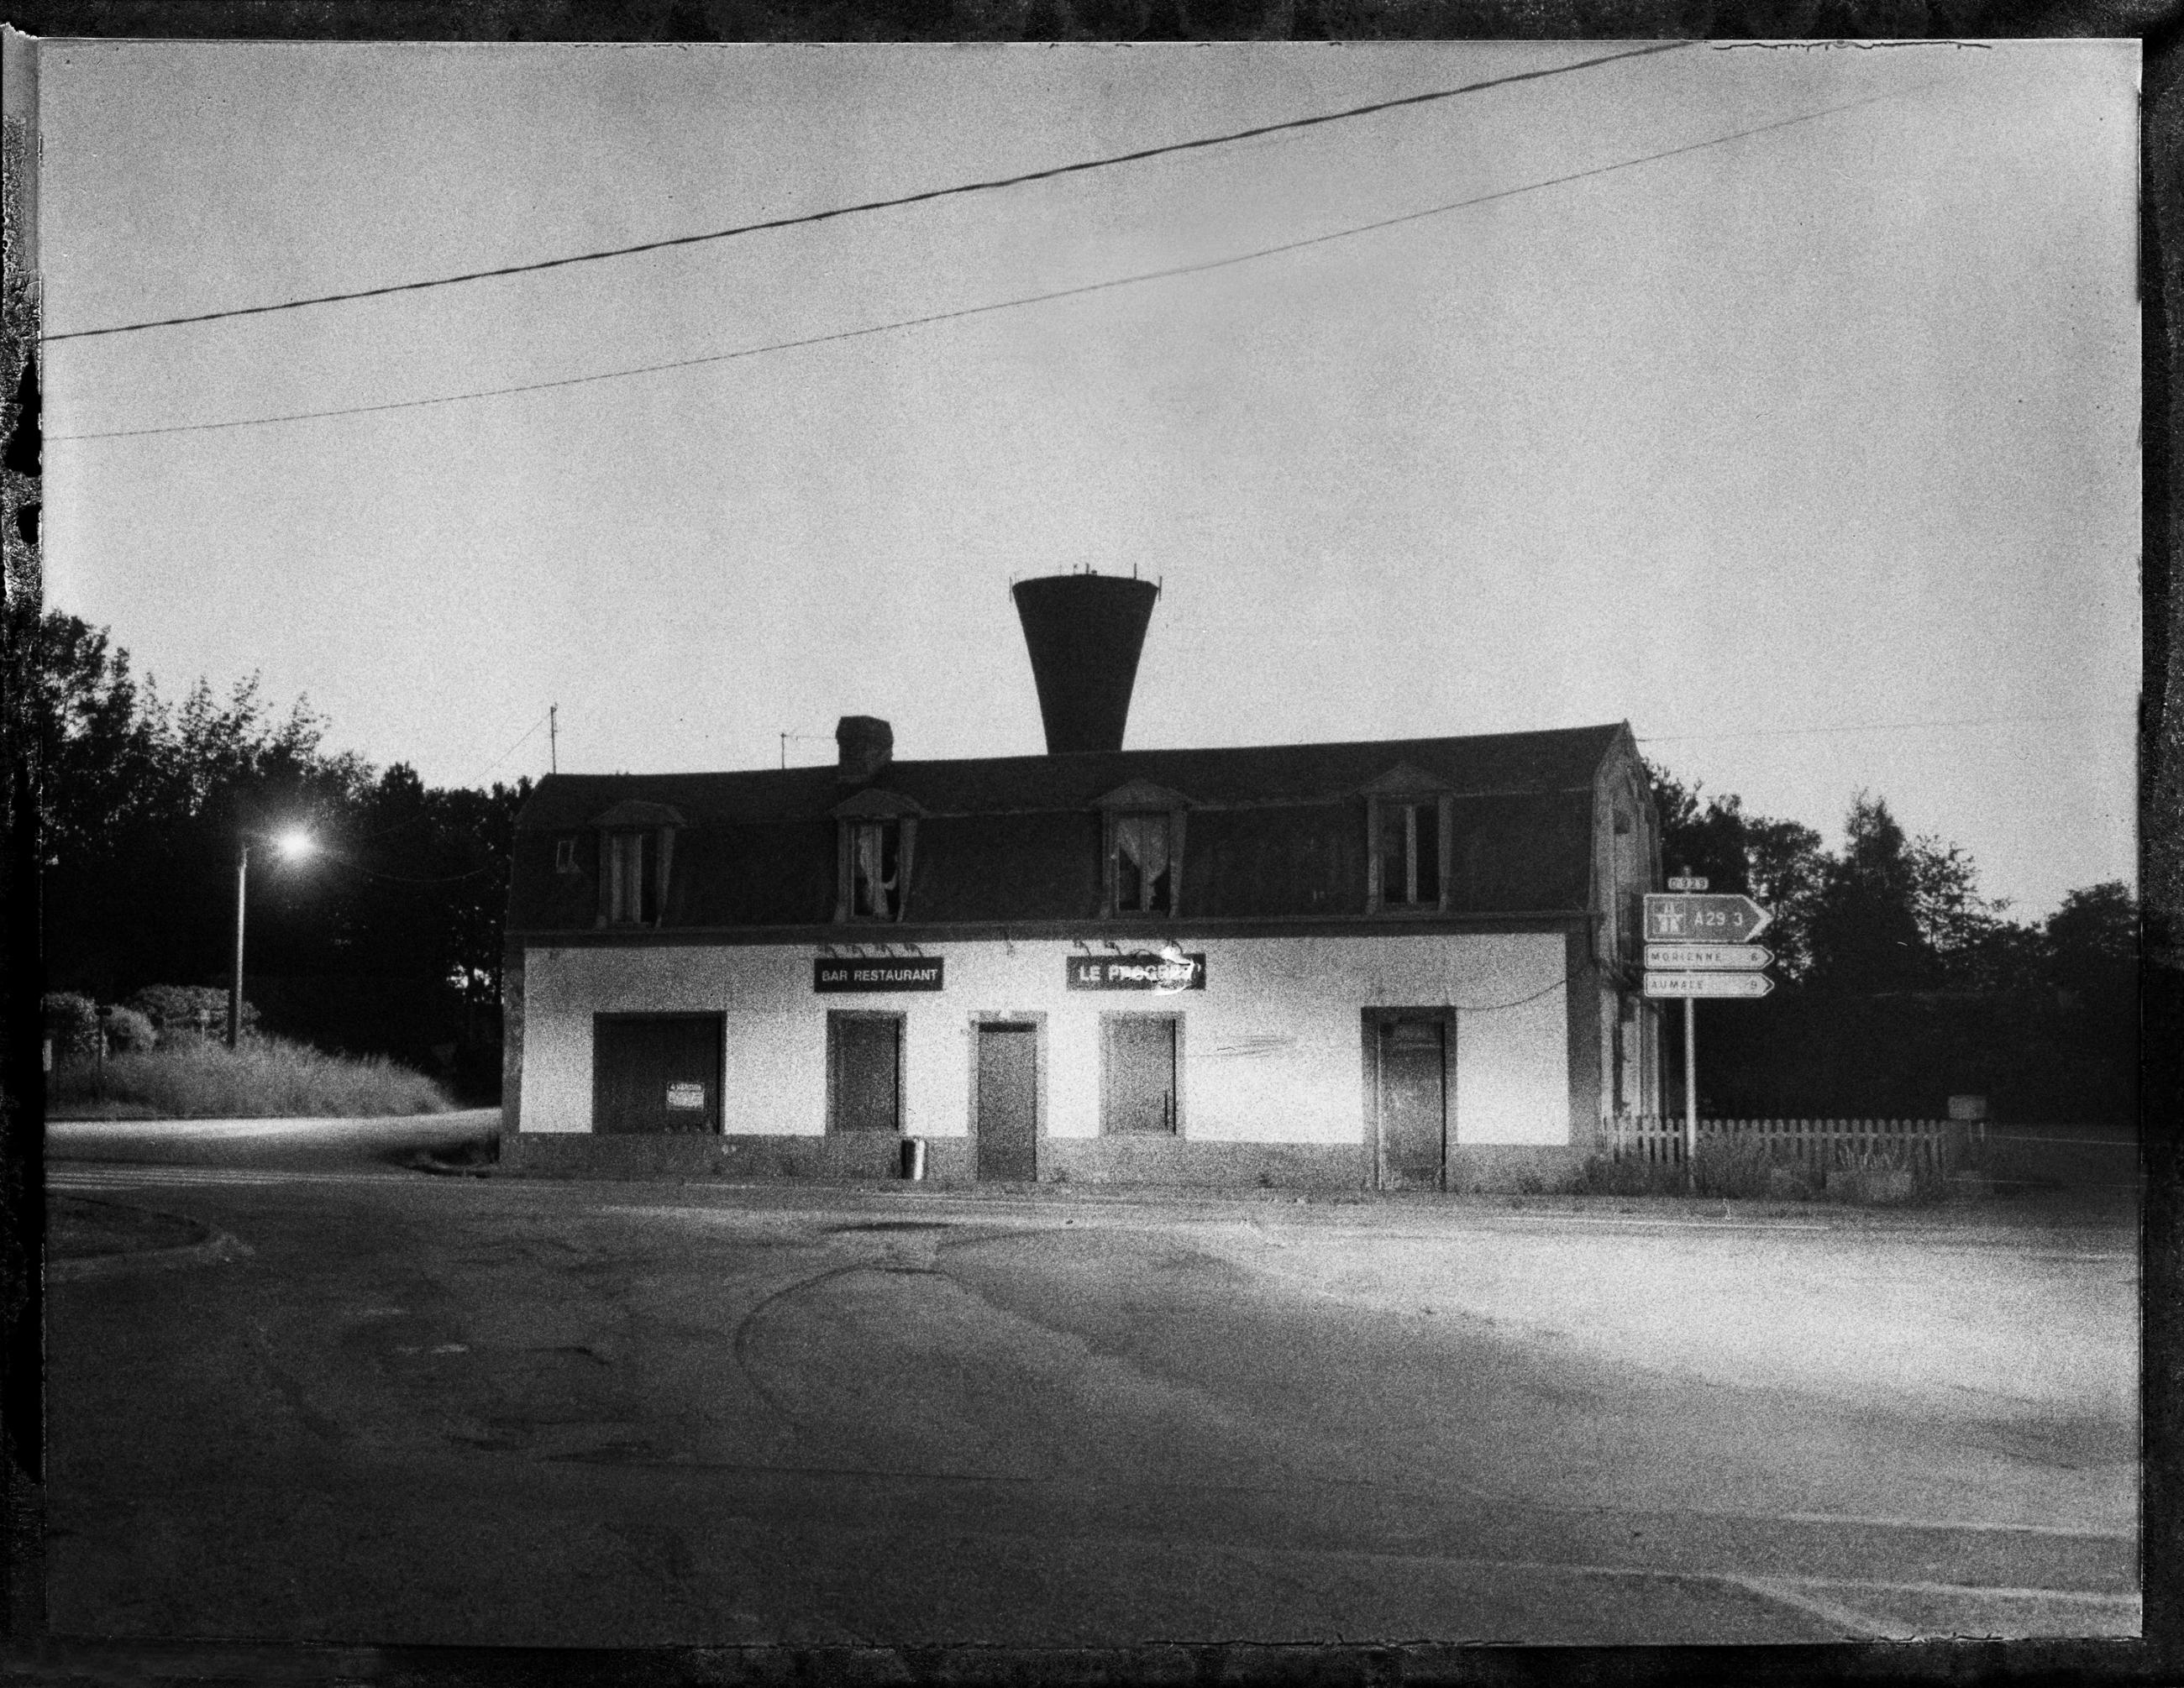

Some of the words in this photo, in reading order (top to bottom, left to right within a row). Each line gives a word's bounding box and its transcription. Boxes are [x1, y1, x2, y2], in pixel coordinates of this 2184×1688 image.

[1733, 911, 1743, 926] 3
[1651, 952, 1722, 962] MORIENNE
[822, 970, 848, 982] BAR
[853, 968, 939, 982] RESTAURANT
[1079, 965, 1100, 982] LE
[1651, 980, 1704, 990] AUMALE
